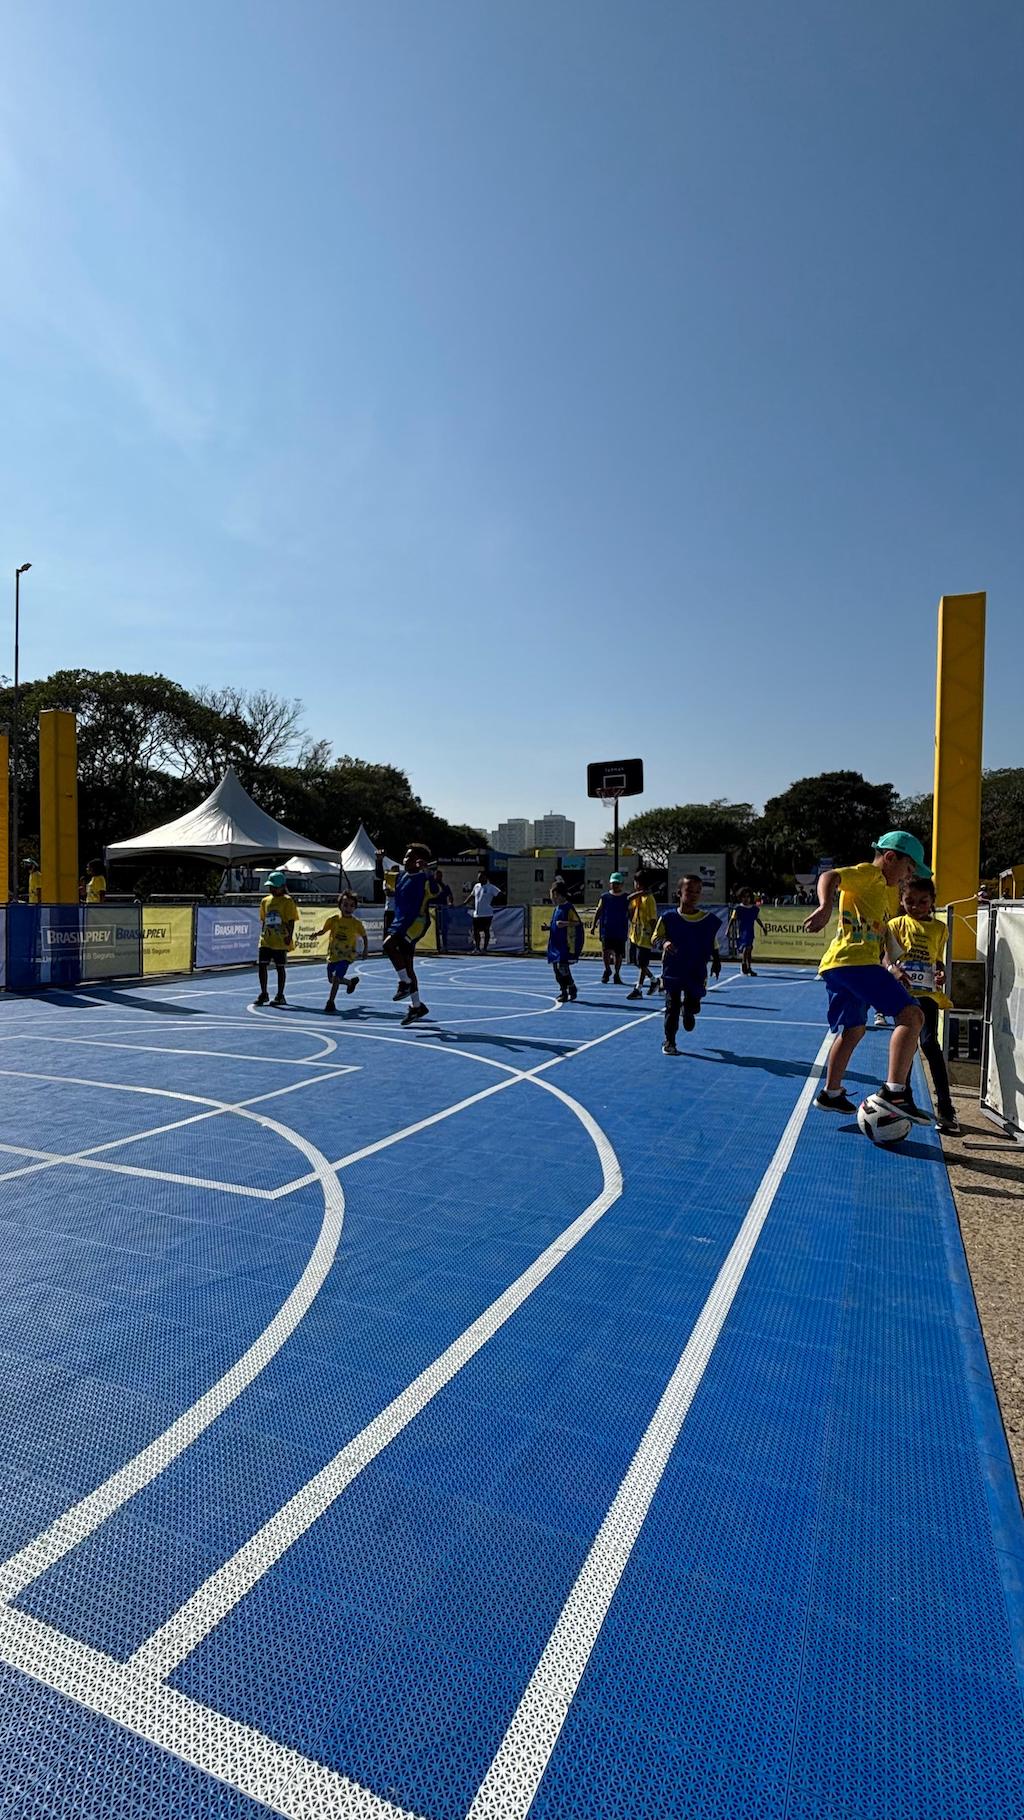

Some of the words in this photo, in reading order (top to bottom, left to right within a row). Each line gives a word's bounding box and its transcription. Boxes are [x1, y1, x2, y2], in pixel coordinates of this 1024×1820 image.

[215, 924, 249, 936] BRASILPREV
[47, 929, 111, 945] BRASILPREV
[295, 941, 320, 949] Passear
[911, 972, 924, 981] 80
